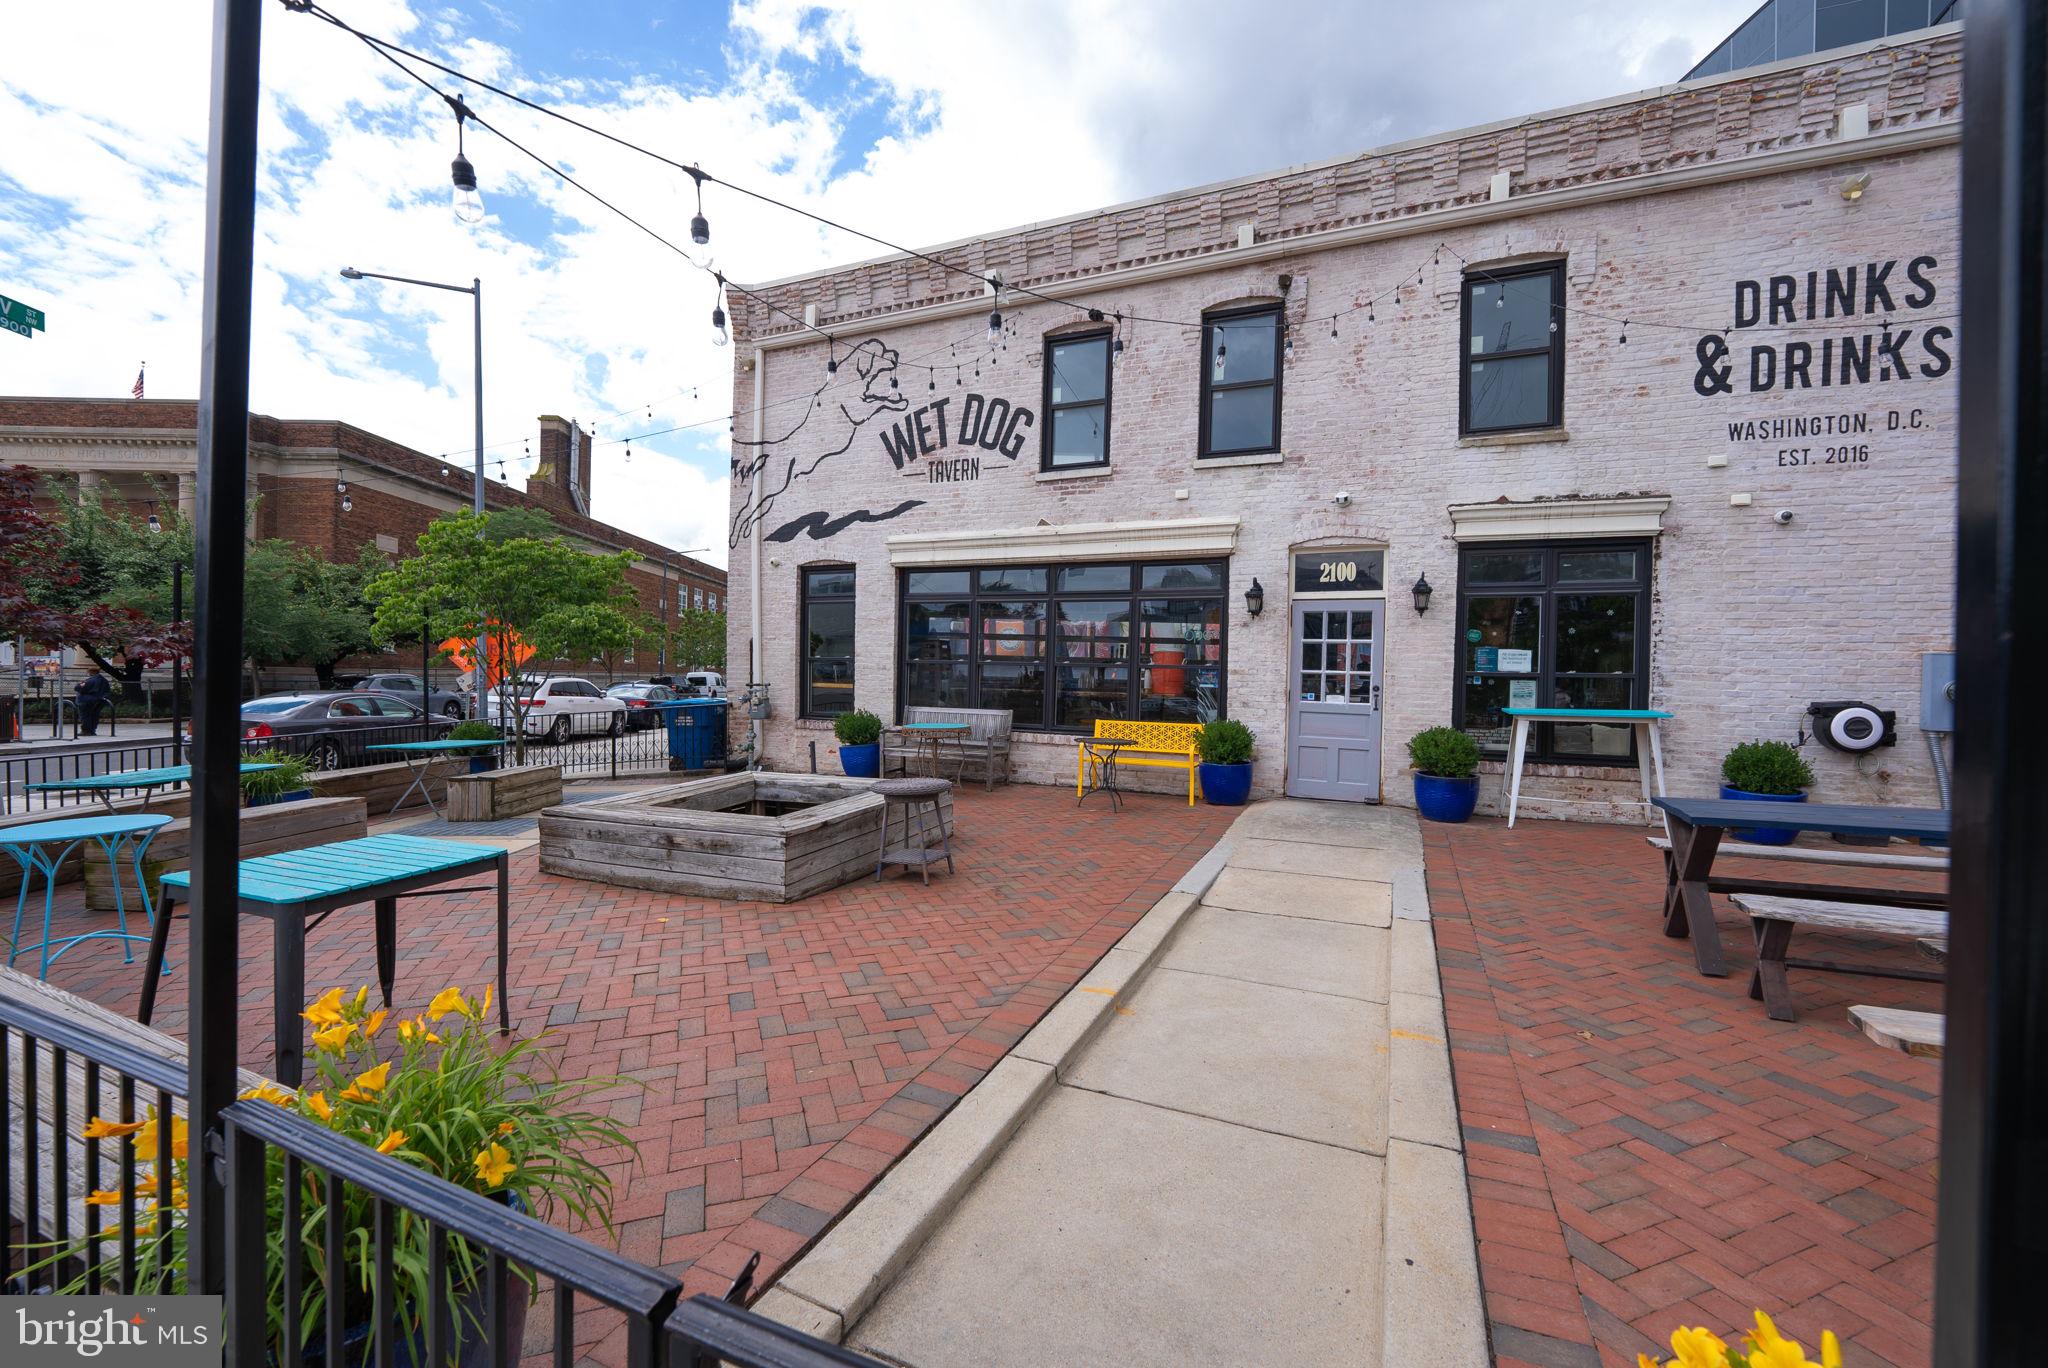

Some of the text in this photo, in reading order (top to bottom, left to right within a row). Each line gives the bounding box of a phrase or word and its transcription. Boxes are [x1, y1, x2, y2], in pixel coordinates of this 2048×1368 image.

[1734, 255, 1938, 329] DRINKS
[0, 317, 28, 335] 900
[26, 309, 37, 318] ST
[1693, 326, 1953, 397] & DRINKS
[879, 393, 1035, 470] WET DOG
[1728, 409, 1930, 442] WASHINGTON, D.C.
[24, 447, 65, 457] JUNIOR
[77, 448, 106, 458] HIGH
[118, 449, 165, 459] SCHOOL
[1778, 445, 1869, 468] EST. 2016
[928, 457, 980, 484] TAVERN
[1319, 561, 1357, 583] 2100
